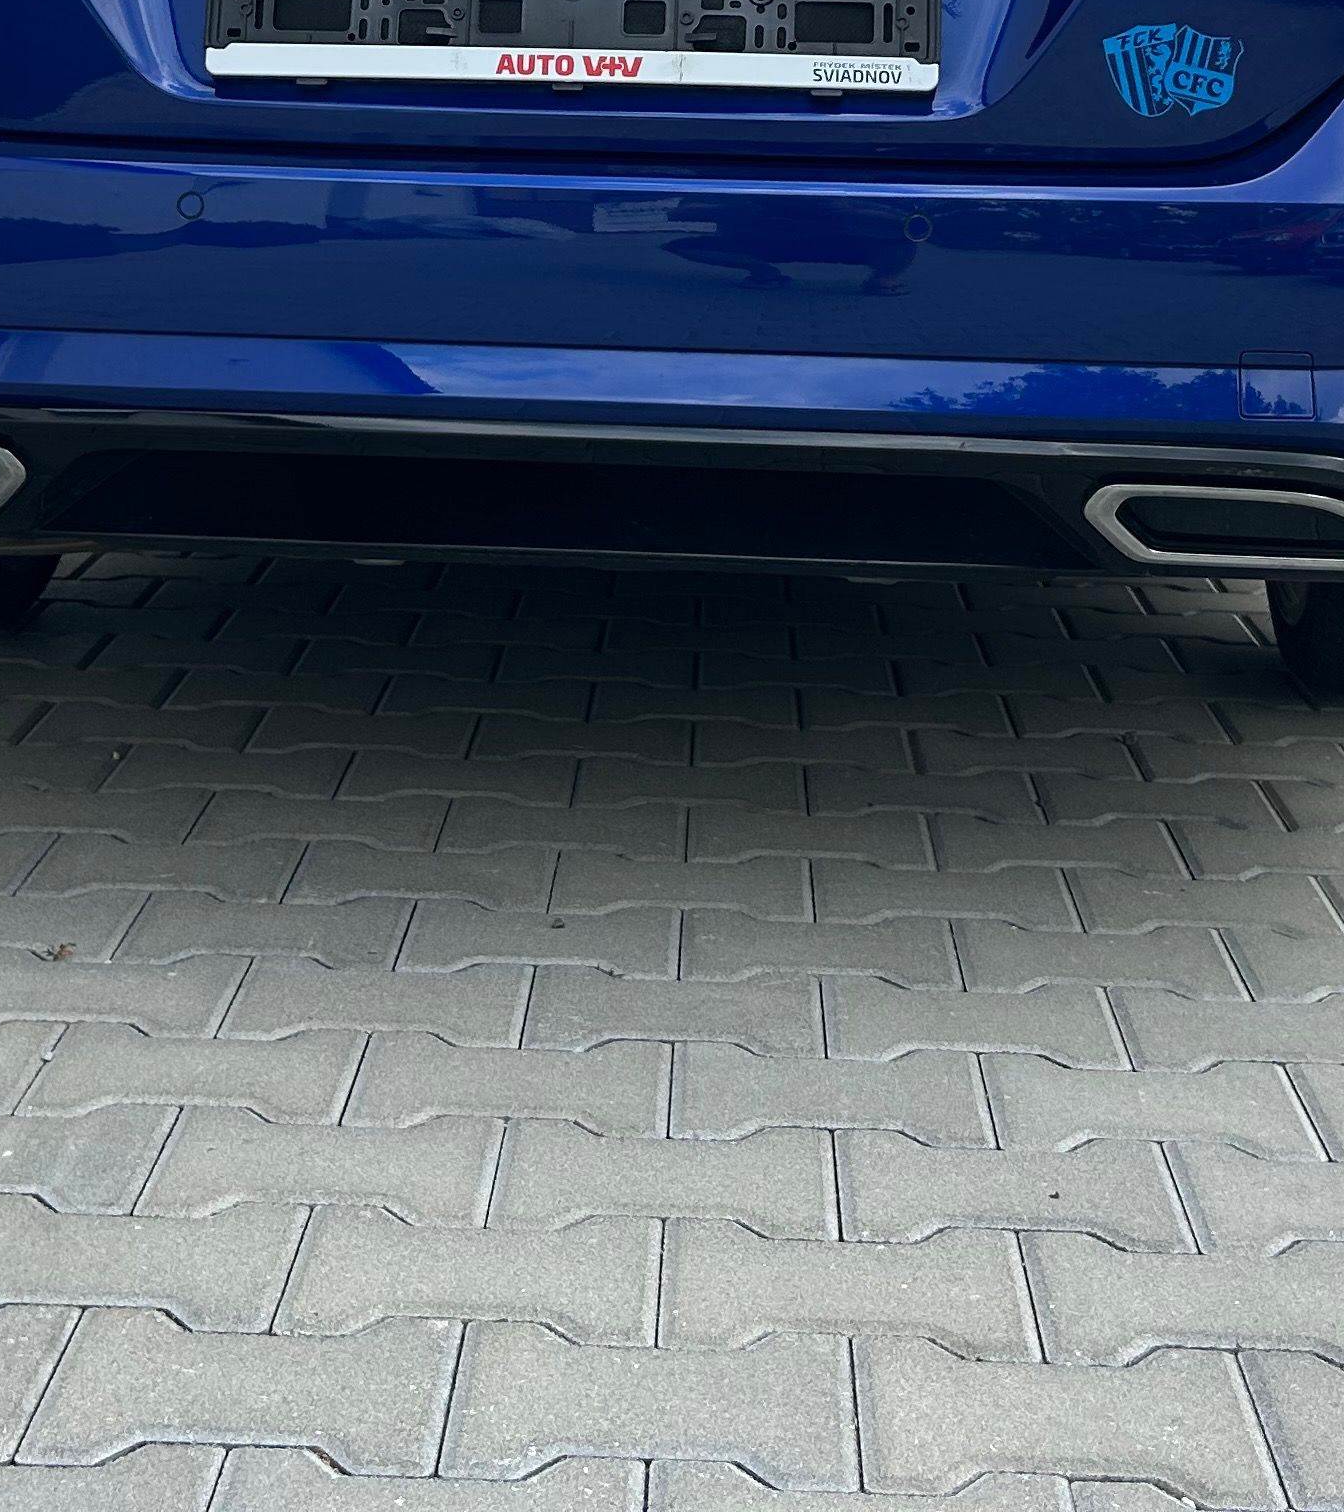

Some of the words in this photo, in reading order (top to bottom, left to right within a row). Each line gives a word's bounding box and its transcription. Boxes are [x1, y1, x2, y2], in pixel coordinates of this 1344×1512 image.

[495, 53, 575, 76] AUTO
[812, 68, 903, 85] SVIADNOV
[1172, 69, 1225, 98] CFC
